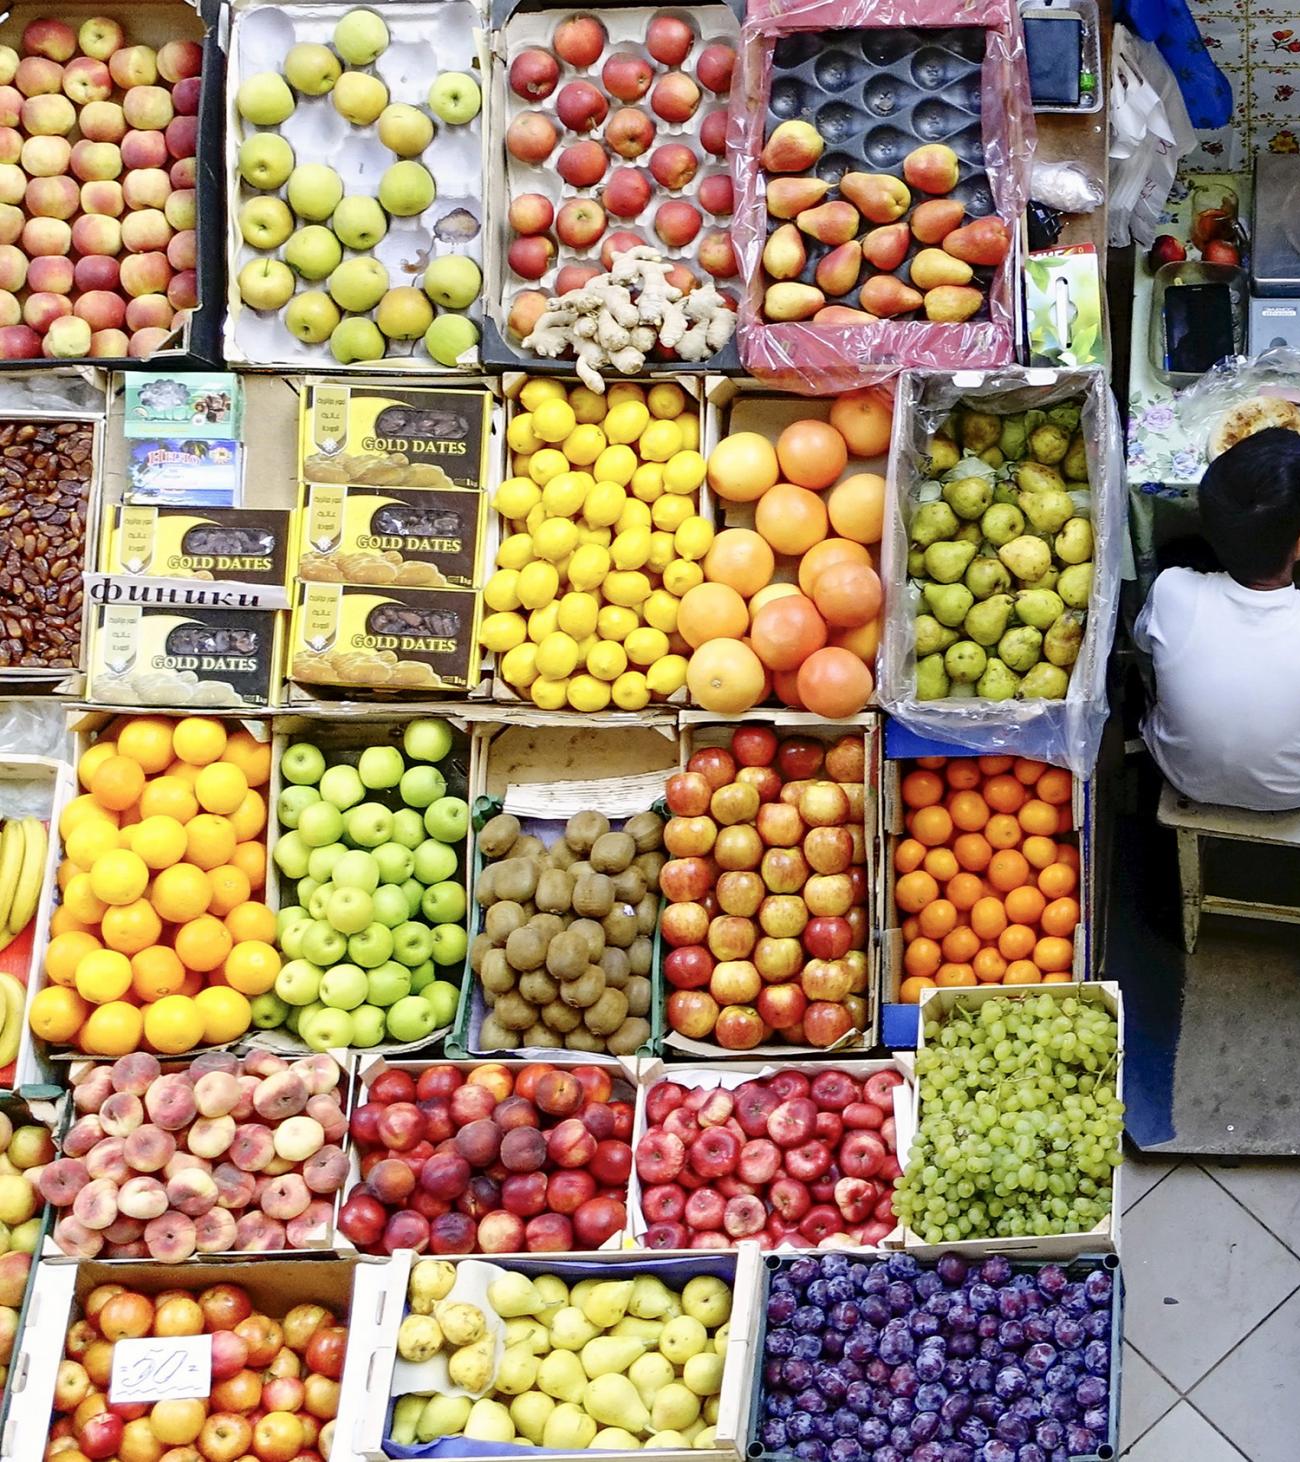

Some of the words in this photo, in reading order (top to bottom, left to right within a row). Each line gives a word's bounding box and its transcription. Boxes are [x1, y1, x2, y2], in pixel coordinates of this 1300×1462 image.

[362, 438, 408, 452] GOLD
[412, 440, 467, 455] DATES
[357, 535, 403, 550] GOLD
[407, 537, 462, 552] DATES
[167, 555, 214, 569] GOLD
[217, 557, 272, 571] DATES
[90, 577, 263, 607] финики
[351, 634, 398, 650] GOLD
[402, 636, 458, 652] DATES
[151, 655, 199, 670] GOLD
[202, 657, 257, 672] DATES
